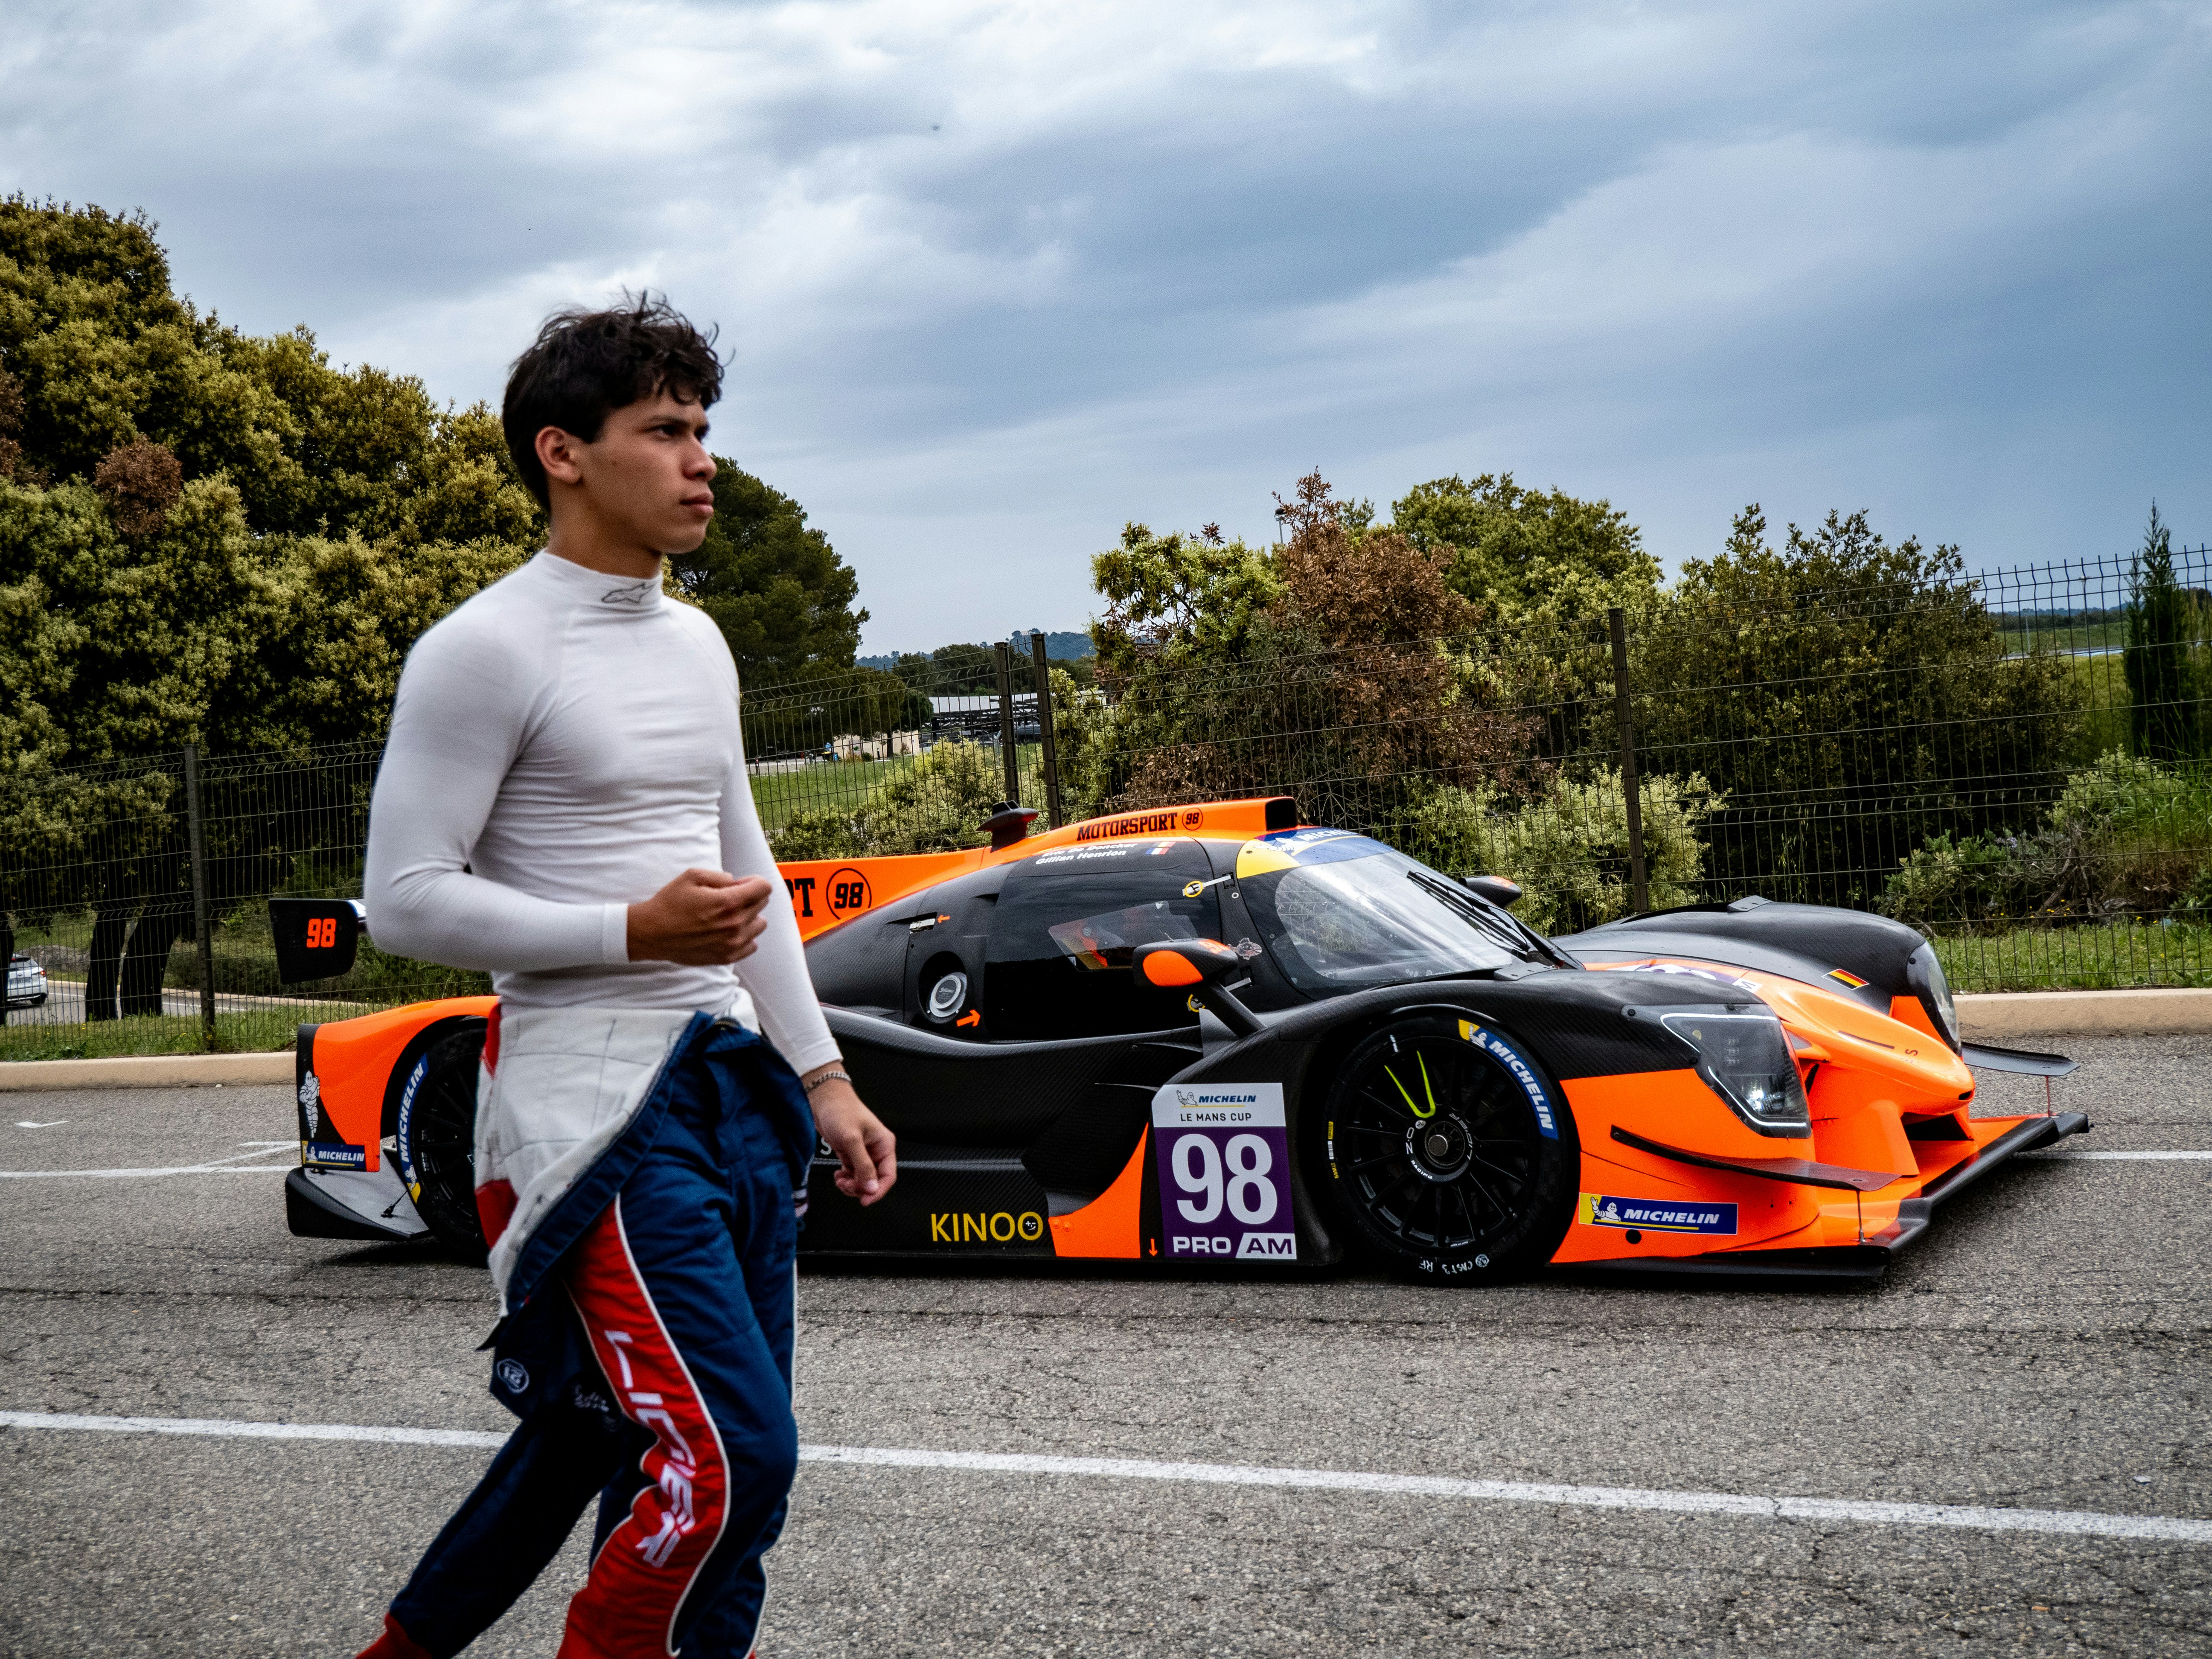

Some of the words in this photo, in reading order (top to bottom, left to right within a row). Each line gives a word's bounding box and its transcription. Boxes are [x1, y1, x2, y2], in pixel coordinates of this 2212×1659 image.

[1077, 813, 1177, 841] MOTORSPORT
[1185, 812, 1200, 824] 98
[1036, 855, 1074, 865] Gillian
[1077, 850, 1127, 859] Henrion
[834, 882, 864, 909] 98
[306, 919, 337, 948] 98
[1488, 1040, 1553, 1130] MICHELIN
[1199, 1095, 1256, 1103] MICHELIN
[399, 1062, 424, 1162] MICHELIN
[1181, 1113, 1192, 1121] LE
[1196, 1113, 1226, 1121] MANS
[1231, 1113, 1252, 1121] CUP
[318, 1151, 365, 1161] MICHELIN
[1172, 1133, 1278, 1225] 98
[1411, 1160, 1433, 1179] RACING
[931, 1212, 1043, 1242] KINOO
[1624, 1208, 1720, 1225] MICHELIN
[1173, 1236, 1231, 1254] PRO
[1246, 1238, 1292, 1254] AM
